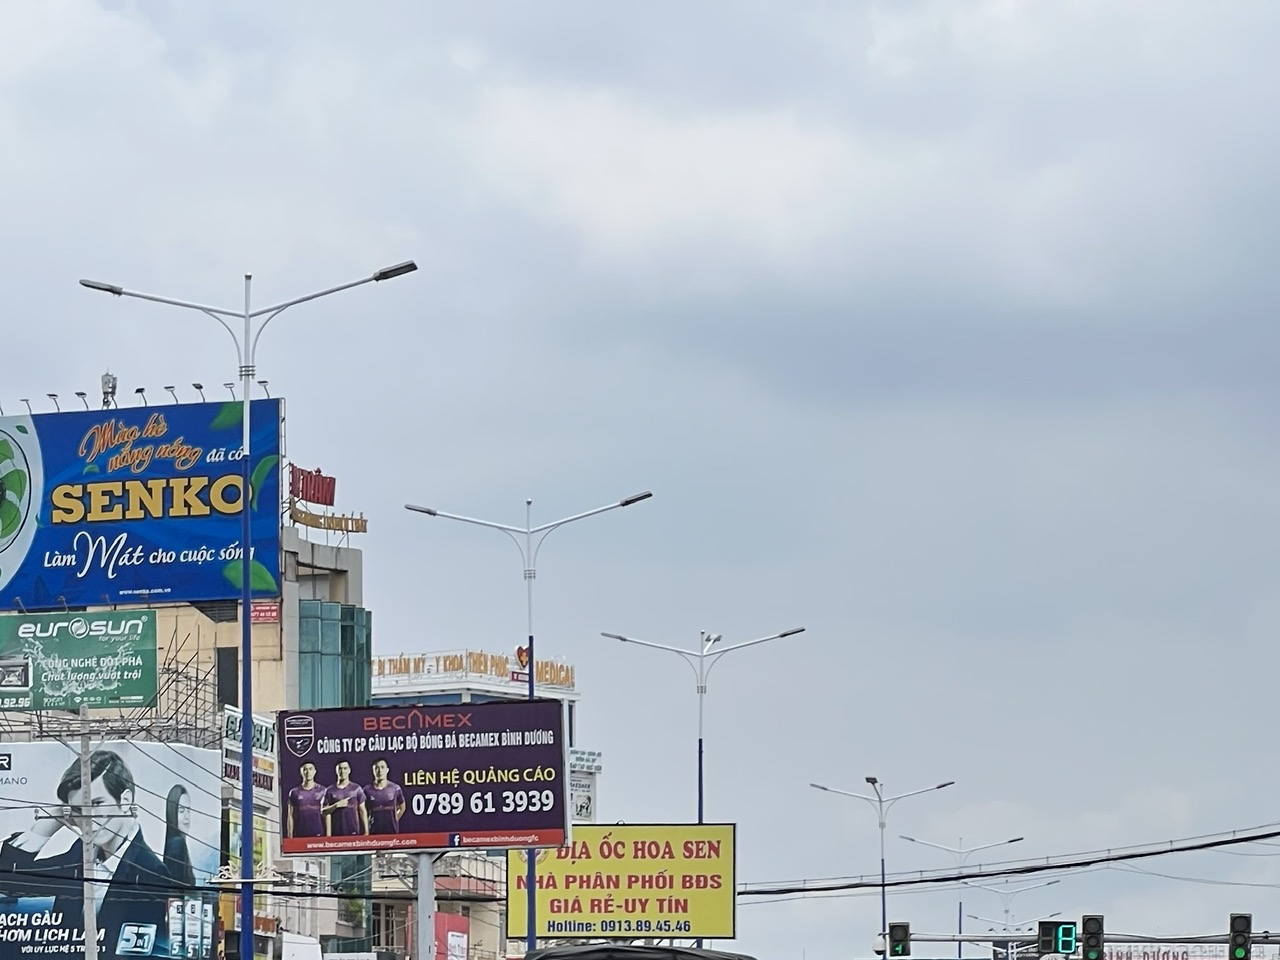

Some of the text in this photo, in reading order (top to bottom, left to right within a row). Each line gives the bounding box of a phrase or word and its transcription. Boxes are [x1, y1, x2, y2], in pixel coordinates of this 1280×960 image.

[142, 413, 168, 438] hè
[206, 447, 225, 463] đã
[227, 445, 244, 461] có
[51, 474, 253, 524] SENKO
[44, 551, 77, 567] Làm
[74, 531, 144, 579] Mát
[149, 549, 176, 564] cho
[180, 546, 215, 568] cuộc
[123, 669, 142, 680] trội
[363, 710, 472, 731] BECAMEX
[317, 729, 554, 753] CÔNG TY CP CÂU LẠC BỘ BÓNG ĐÁ BECAMEX BÌNH DƯƠNG
[404, 766, 556, 788] LIÊN HỆ QUẢNG CÁO
[412, 789, 554, 816] 0789 61 3939
[307, 839, 417, 849] www.becamexbinhduongfc.com
[463, 834, 539, 844] becamexbinhduongfc
[556, 832, 721, 865] ĐỊA ỐC HOA SEN
[565, 871, 620, 890] PHÂN
[627, 869, 675, 890] PHỐI
[681, 874, 722, 889] BĐS
[549, 894, 583, 914] GIÁ
[656, 894, 689, 914] TÍN
[31, 910, 63, 926] GÀU
[547, 919, 691, 933] Hotline: 0913.89.45.46
[35, 929, 70, 945] LỊCH
[1059, 925, 1076, 954] 8
